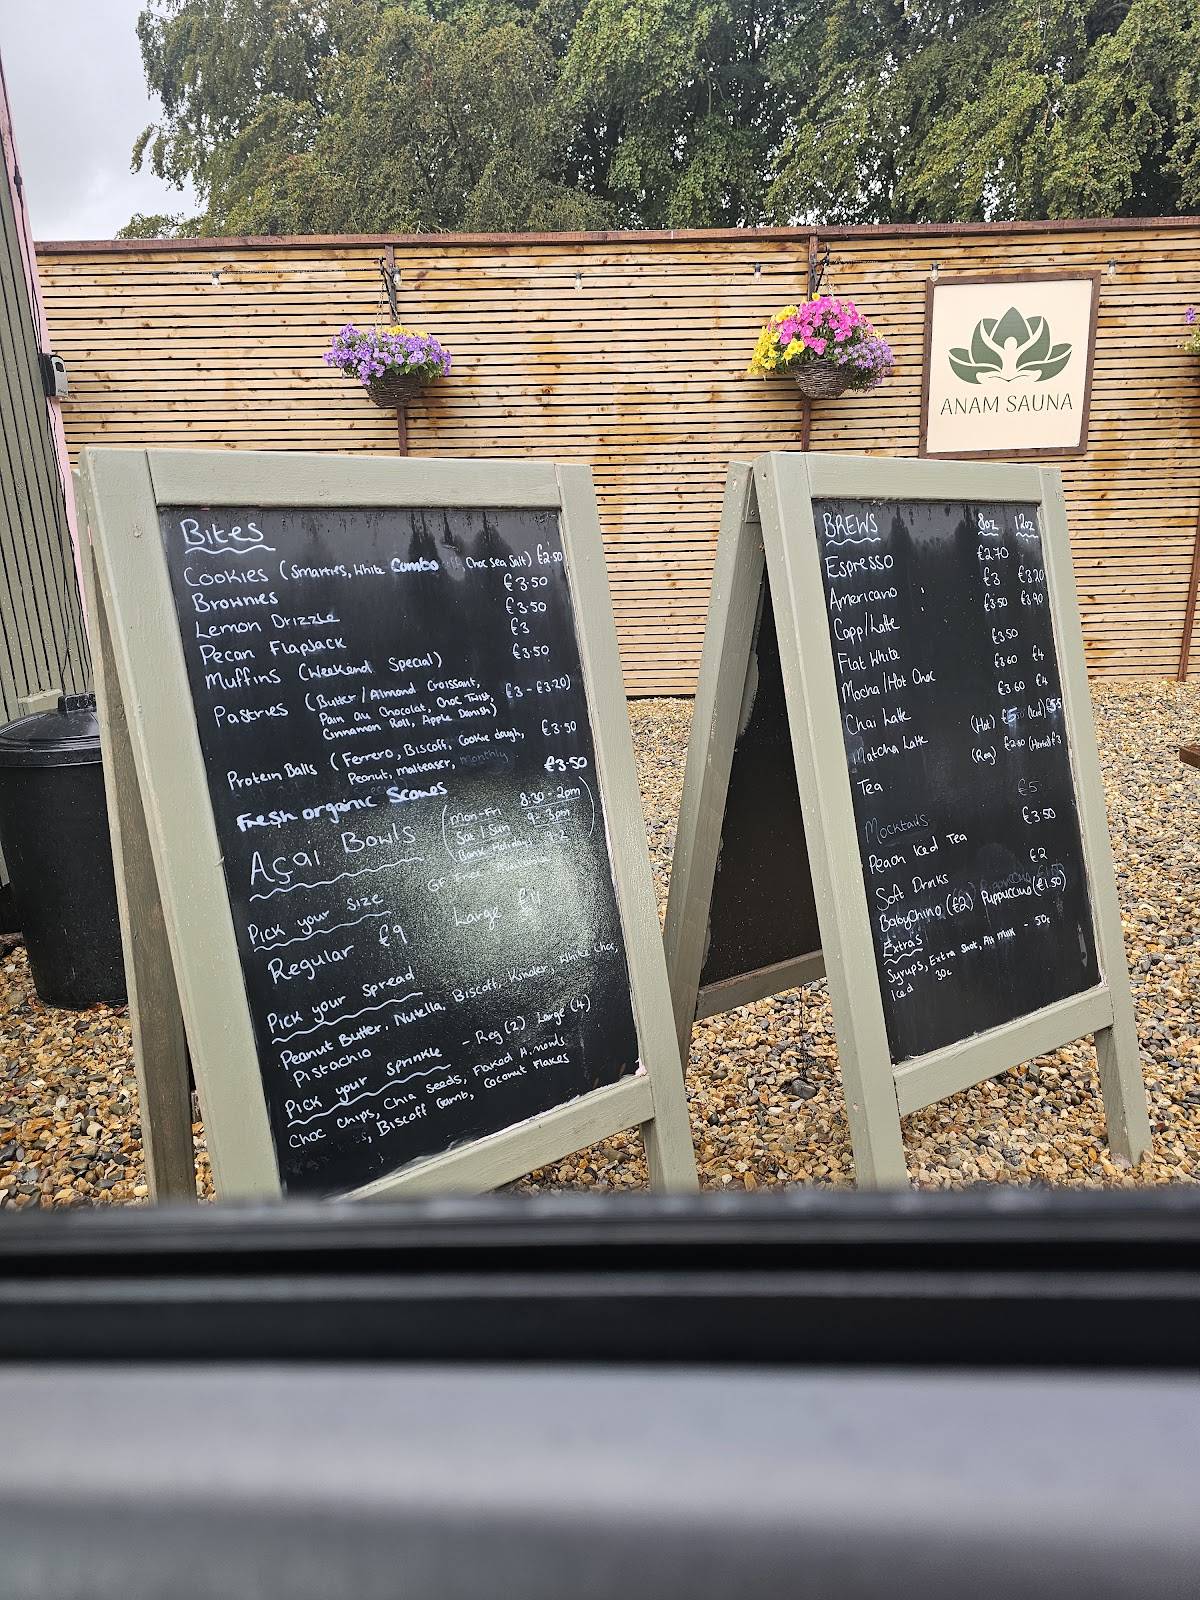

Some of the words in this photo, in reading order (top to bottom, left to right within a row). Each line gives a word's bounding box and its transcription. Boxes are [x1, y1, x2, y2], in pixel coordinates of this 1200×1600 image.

[941, 397, 999, 415] ANAM
[1006, 393, 1072, 412] SAUNA
[180, 519, 264, 545] Bites
[823, 512, 878, 537] BREWS
[978, 513, 999, 530] 8oz
[1015, 513, 1035, 531] 12oz
[184, 567, 269, 587] Cookies
[825, 555, 894, 578] Espresso
[977, 545, 1009, 560] €2.70
[192, 592, 278, 612] Brownies
[504, 574, 548, 592] €3.50
[830, 587, 897, 611] Americano
[983, 567, 1000, 586] €3
[984, 593, 1008, 611] €3.50
[196, 620, 261, 638] Lemon
[271, 613, 340, 628] Drizzle
[506, 597, 547, 614] €3.50
[200, 645, 255, 665] Pecan
[511, 618, 530, 635] €3
[838, 653, 866, 674] Flat
[870, 647, 901, 667] White
[992, 628, 1018, 645] €3.50
[1032, 645, 1044, 661] €4
[205, 666, 282, 690] Muffins
[513, 643, 549, 659] €3.50
[214, 703, 289, 727] Pastries
[319, 713, 344, 726] Pain
[354, 712, 370, 720] au
[423, 714, 452, 726] Apple
[845, 714, 876, 735] Chai
[883, 708, 912, 726] Latte
[998, 681, 1025, 695] €3.60
[1036, 673, 1048, 687] €4
[903, 735, 928, 749] Latte
[971, 714, 995, 734] (Hot)
[227, 771, 282, 790] Protein
[284, 763, 318, 778] Balls
[542, 720, 577, 736] €3.50
[857, 778, 883, 796] Tea
[971, 746, 996, 765] (Reg)
[236, 810, 298, 832] Fresh
[302, 796, 377, 824] organic
[544, 756, 588, 771] €3.50
[348, 769, 393, 785] Peanut,
[341, 823, 416, 853] Bowls
[869, 854, 906, 874] Peach
[913, 836, 939, 857] Iced
[946, 833, 968, 845] Tea
[1022, 806, 1056, 824] €3.50
[912, 873, 949, 894] Drinks
[1030, 847, 1048, 862] €2
[454, 908, 501, 930] Large
[946, 892, 974, 915] (€2)
[248, 924, 286, 945] Pick
[297, 910, 329, 935] your
[883, 933, 923, 957] Extras
[268, 945, 354, 984] Regular
[891, 983, 914, 1001] Iced
[935, 968, 952, 980] 30c
[267, 1011, 304, 1033] Pick
[312, 996, 346, 1023] your
[280, 1041, 334, 1070] Peanut
[285, 1096, 323, 1119] Pick
[336, 1077, 368, 1103] your
[475, 1030, 503, 1045] Reg
[505, 1016, 525, 1034] (2)
[537, 1006, 565, 1025] Large
[571, 994, 591, 1012] (4)
[293, 1048, 371, 1088] Pistachio
[289, 1128, 326, 1148] Choc
[384, 1093, 417, 1110] Chia
[473, 1053, 513, 1076] Flaked
[377, 1103, 428, 1136] Biscoff
[484, 1065, 527, 1089] Coconut
[533, 1053, 570, 1070] Flakes
